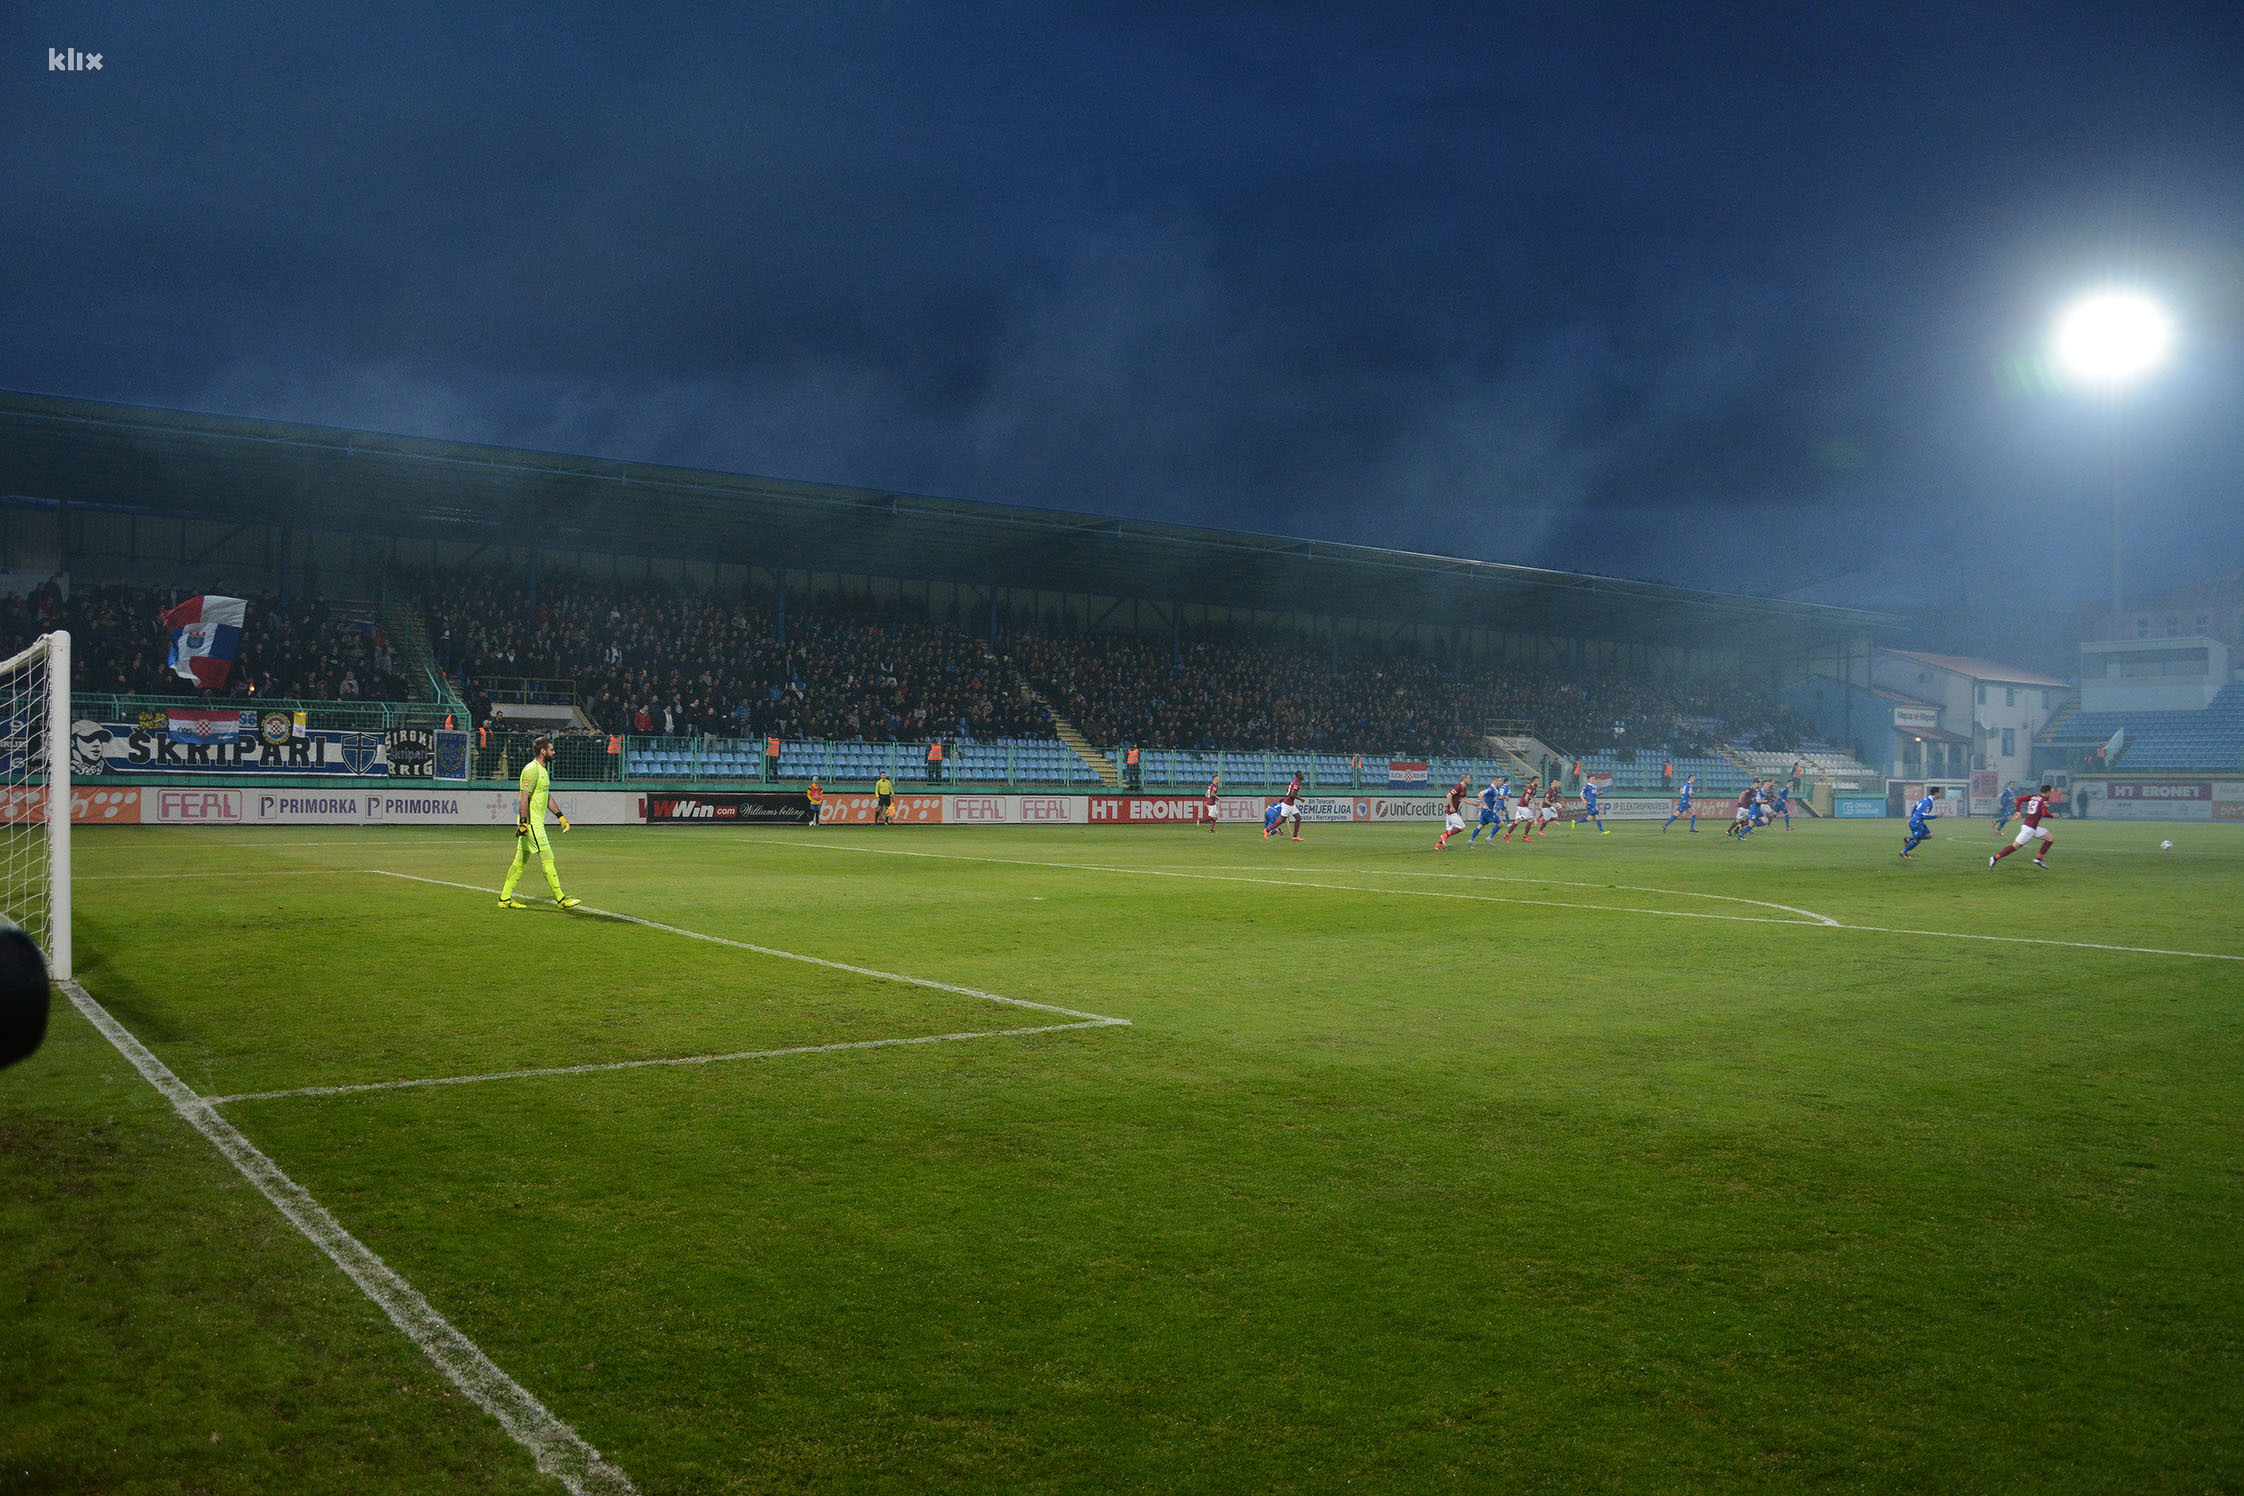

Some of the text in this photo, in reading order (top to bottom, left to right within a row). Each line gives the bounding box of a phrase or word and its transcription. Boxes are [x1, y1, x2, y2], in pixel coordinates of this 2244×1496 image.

[2142, 786, 2200, 797] ERONET
[161, 793, 238, 818] FEAL
[280, 798, 357, 814] PRIMORKA
[385, 799, 459, 815] PRIMORKA
[739, 802, 805, 820] Williams betting
[955, 800, 1004, 819] FEAL
[1022, 800, 1069, 819] FEAL
[1091, 799, 1206, 820] HT ERONET
[1333, 804, 1351, 815] LIGA
[1389, 801, 1462, 817] UniCredit Bk
